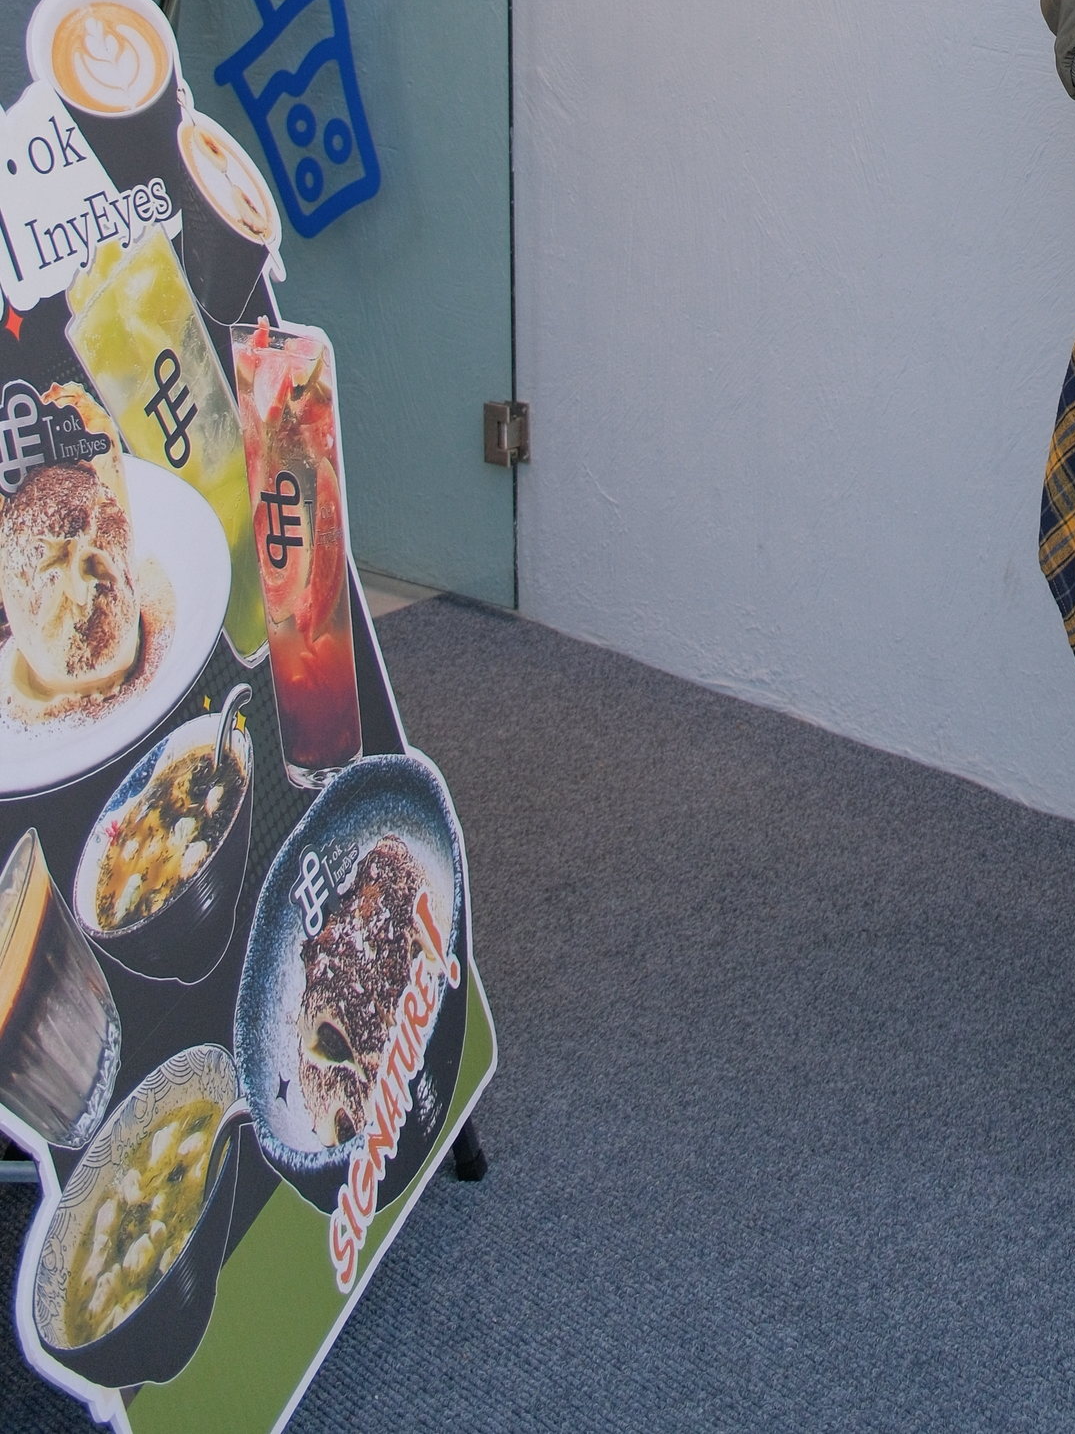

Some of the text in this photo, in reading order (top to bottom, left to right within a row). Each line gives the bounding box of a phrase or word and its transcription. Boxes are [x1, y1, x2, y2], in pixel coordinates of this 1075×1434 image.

[25, 181, 170, 269] InyEyes
[60, 438, 107, 461] InyEyes
[333, 891, 459, 1284] SIGNATURE!
